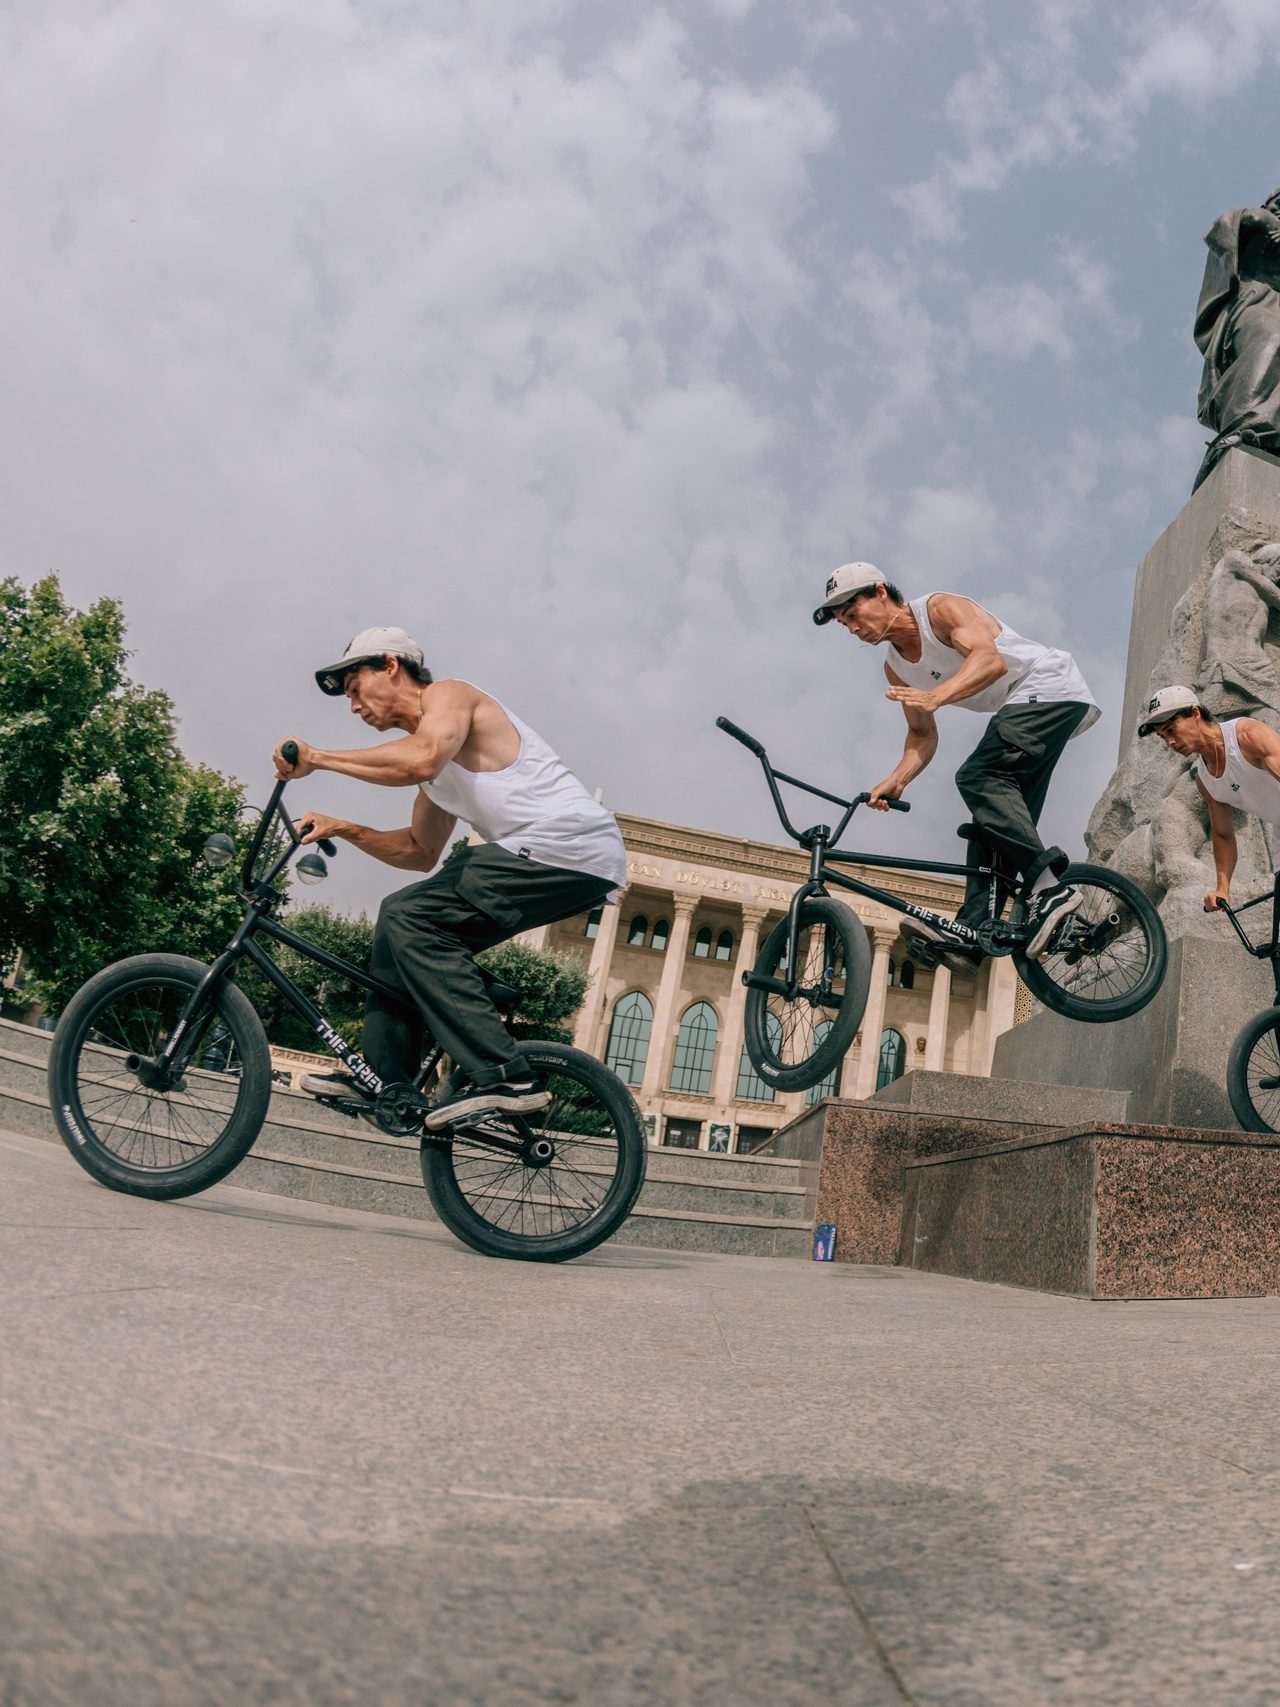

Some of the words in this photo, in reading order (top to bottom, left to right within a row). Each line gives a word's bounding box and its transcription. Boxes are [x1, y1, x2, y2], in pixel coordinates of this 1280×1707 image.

[677, 871, 741, 893] DÖVLƏT
[906, 902, 933, 921] THE
[316, 1018, 349, 1054] THE
